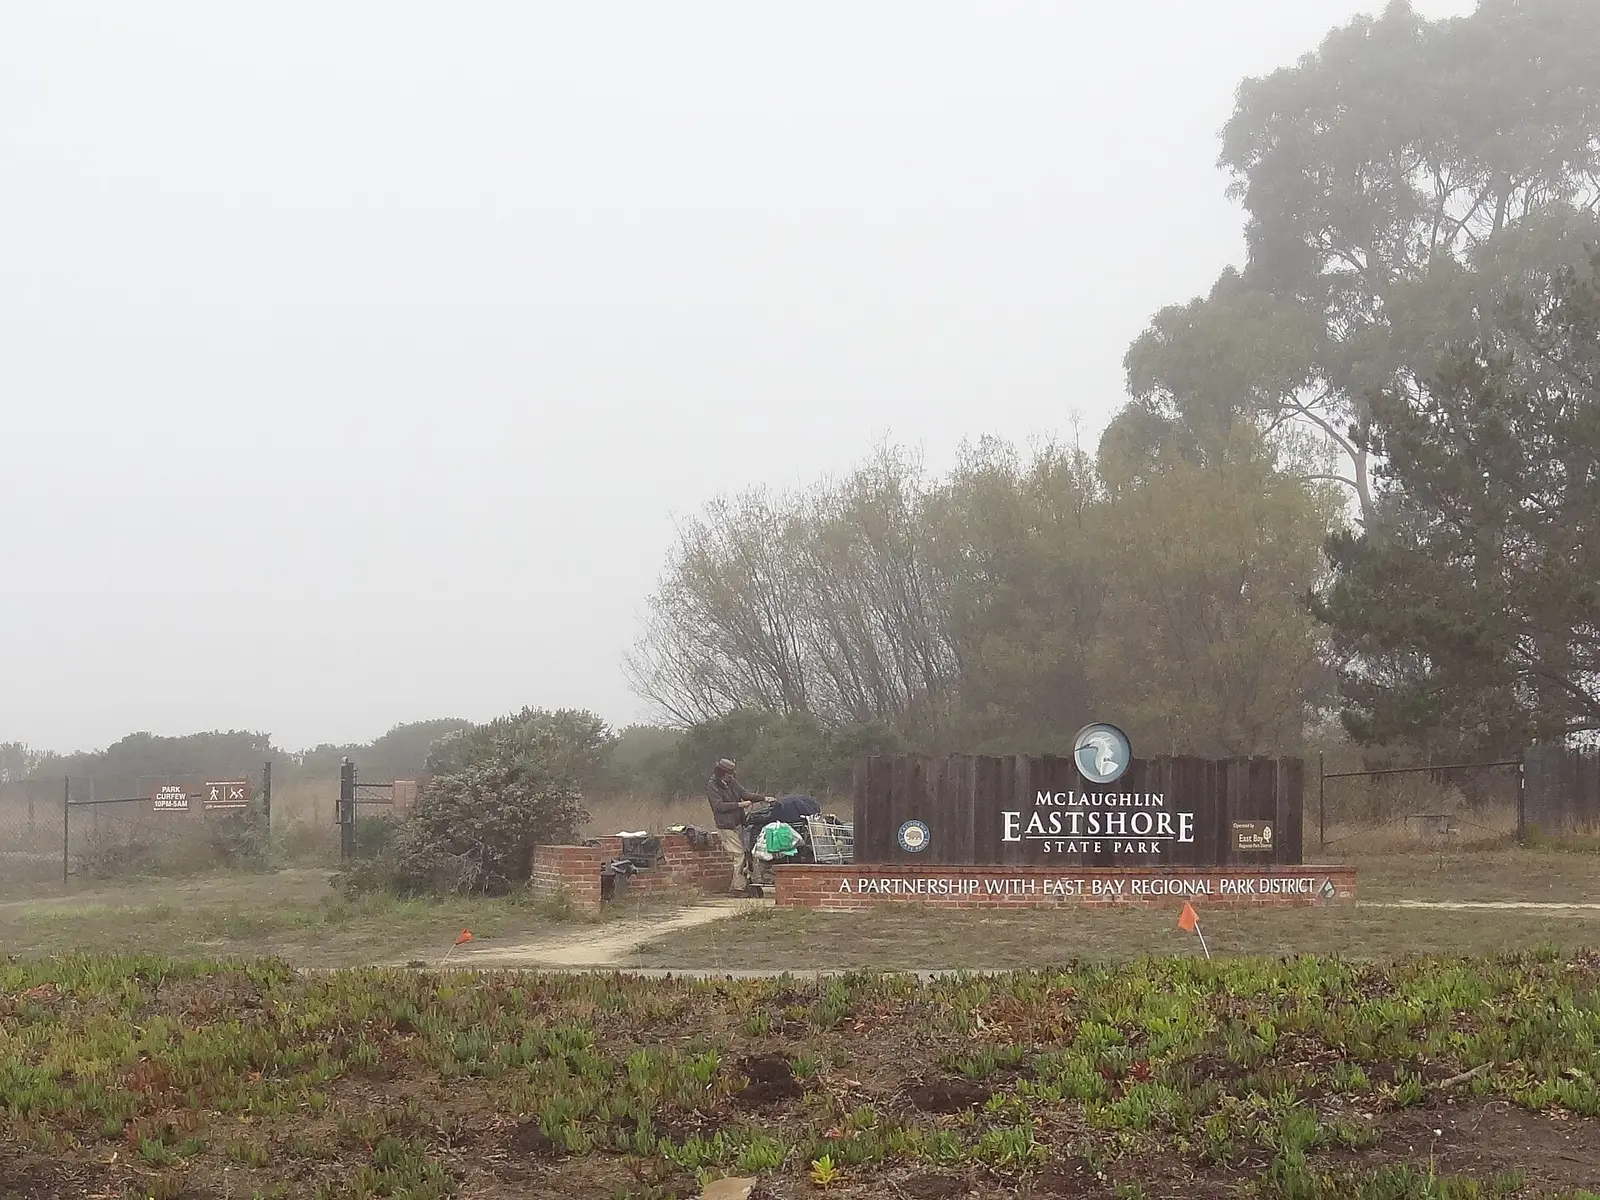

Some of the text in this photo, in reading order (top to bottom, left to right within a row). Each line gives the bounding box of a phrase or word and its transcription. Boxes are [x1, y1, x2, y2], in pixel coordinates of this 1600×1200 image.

[1001, 811, 1194, 843] EASTSHORE
[1239, 834, 1263, 844] East Bay
[1043, 841, 1161, 853] STATE PARK
[838, 878, 1315, 895] A PARTNERSHIP WITH EAST BAY REGIONAL PARK DISTRICT
